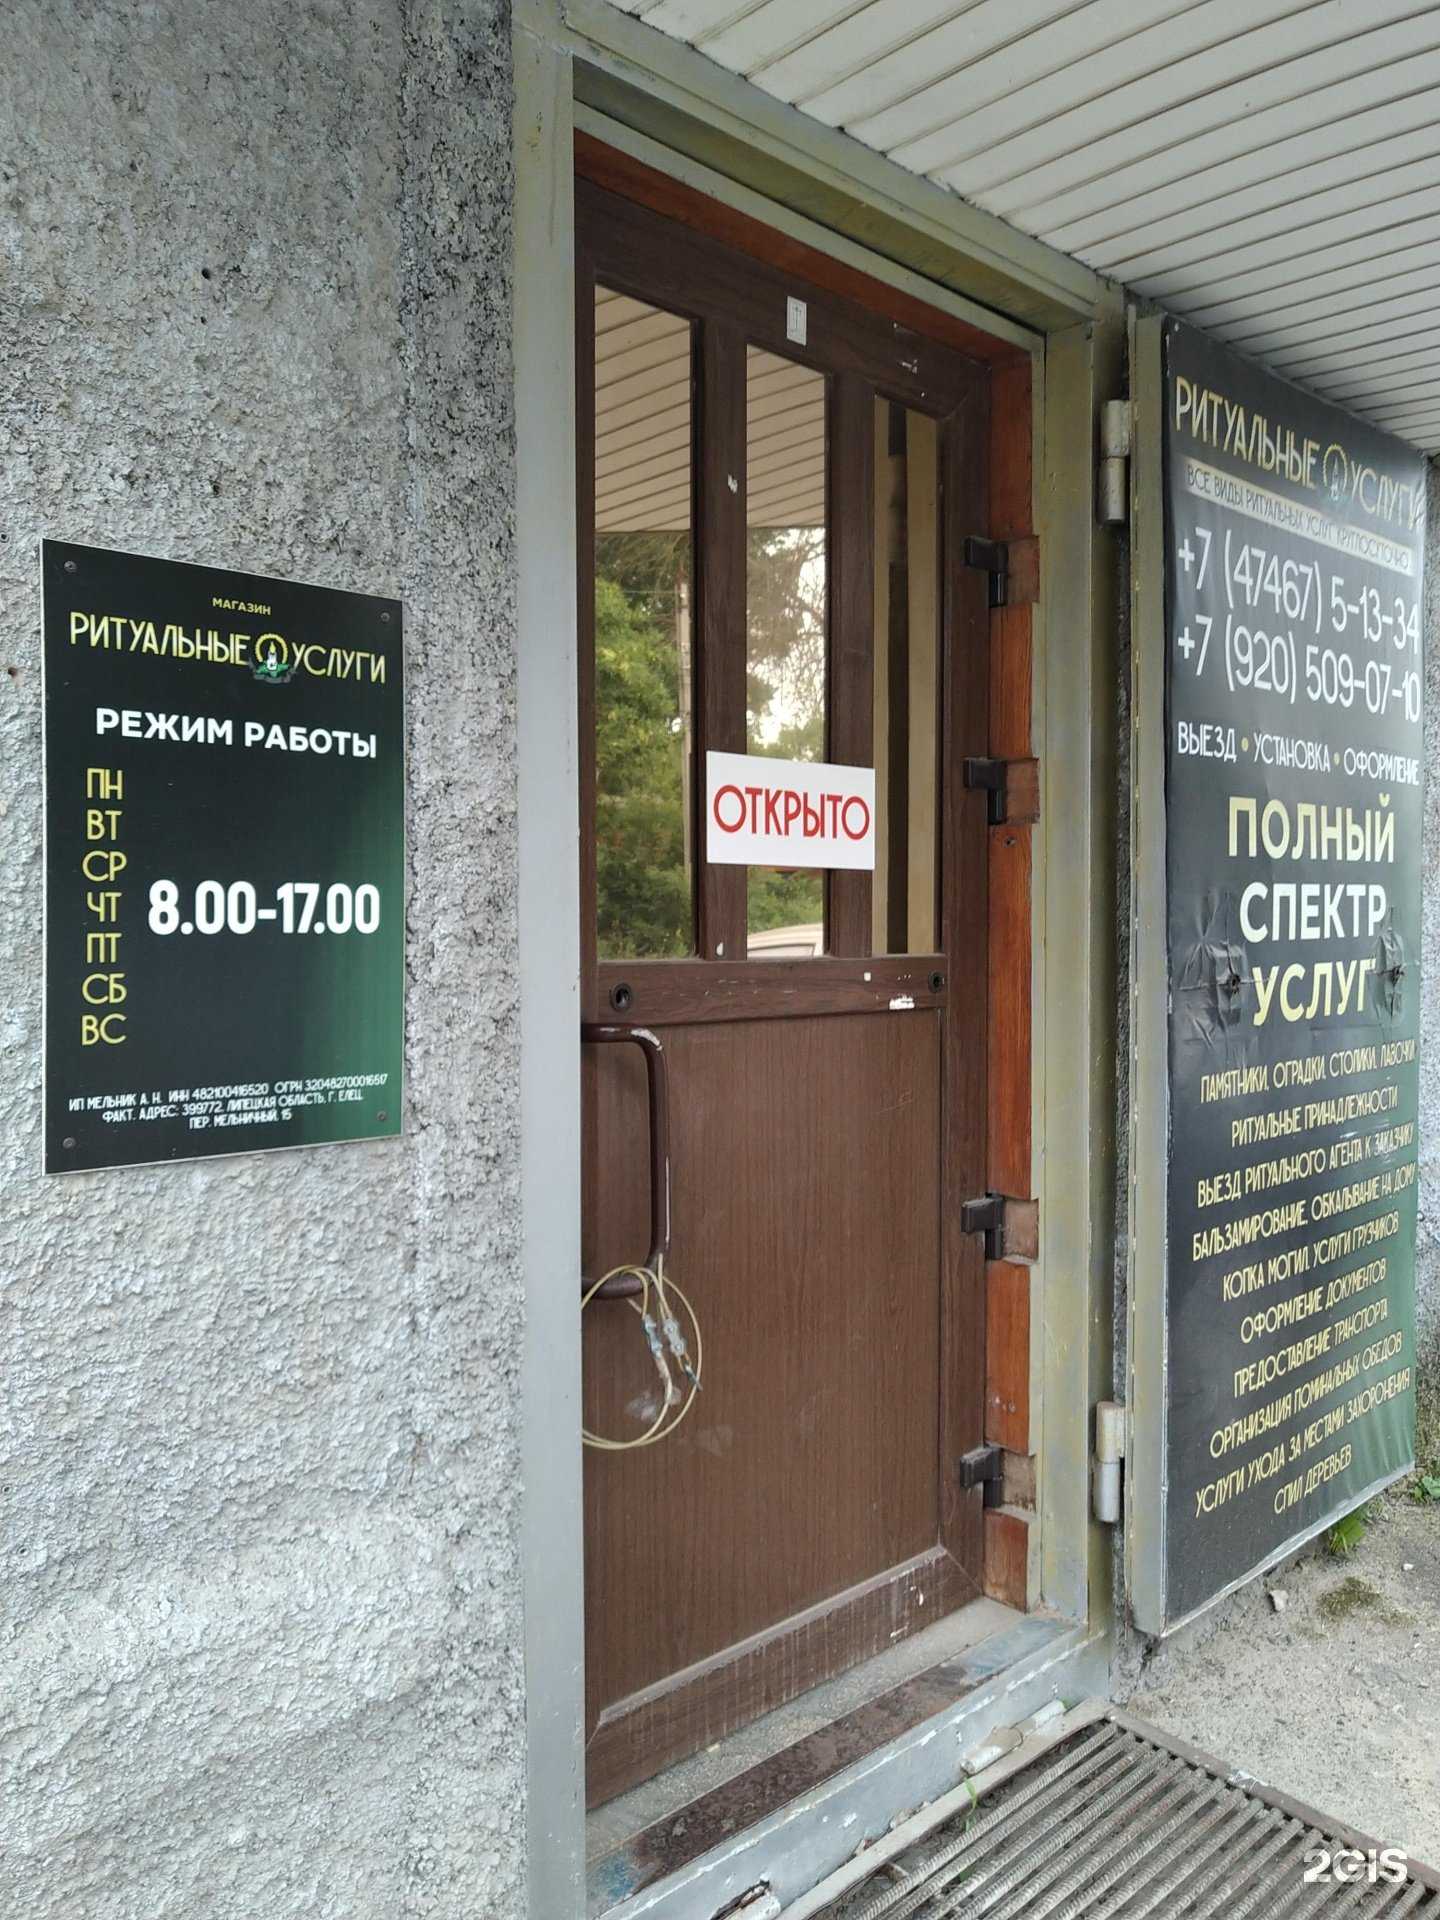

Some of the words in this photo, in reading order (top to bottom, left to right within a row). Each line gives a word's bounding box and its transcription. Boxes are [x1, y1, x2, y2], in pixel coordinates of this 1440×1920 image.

[1176, 376, 1319, 488] РИТУАЛЬНЫЕ
[1187, 465, 1211, 494] ВСЕ
[1214, 476, 1242, 504] ВИДЫ
[212, 597, 271, 615] МАГАЗИН
[1178, 527, 1212, 590] +7
[1224, 529, 1322, 634] (47467)
[1331, 575, 1419, 654] 5-13-34
[70, 611, 250, 666] РИТУАЛЬНЫЕ
[293, 643, 386, 684] УСЛУГИ
[1178, 615, 1212, 676] +7
[1225, 614, 1296, 704] (920)
[1305, 644, 1421, 721] 509-07-10
[96, 708, 233, 745] РЕЖИМ
[245, 721, 377, 759] РАБОТЫ
[1178, 721, 1237, 762] ВЫЕЗД
[1253, 732, 1330, 773] УСТАНОВКА
[1344, 748, 1419, 785] ОФОРМЛЕНИЕ
[85, 768, 124, 801] ПН
[713, 786, 870, 840] ОТКРЫТО
[86, 809, 122, 841] ВТ
[1229, 793, 1395, 863] ПОЛНЫЙ
[81, 850, 127, 881] СР
[87, 892, 122, 922] ЧТ
[147, 880, 380, 935] 8.00-17.00
[1239, 881, 1387, 943] СПЕКТР
[86, 933, 121, 964] ПТ
[81, 973, 128, 1004] СБ
[1252, 959, 1375, 1026] УСЛУГ
[81, 1014, 128, 1046] ВС
[1380, 1039, 1416, 1066] ЛАВОЧКИ
[69, 1098, 84, 1111] ИП
[87, 1093, 137, 1110] МЕЛЬНИК
[169, 1089, 190, 1102] ИНН
[274, 1081, 303, 1093] ОГРН
[102, 1109, 137, 1123] ФАКТ.
[139, 1105, 180, 1120] АДРЕС:
[227, 1096, 276, 1111] ЛИПЕЦКАЯ
[328, 1091, 337, 1103] Г.
[189, 1114, 212, 1129] ПЕР.
[280, 1109, 293, 1121] 15
[1232, 1107, 1301, 1147] РИТУАЛЬНЫЕ
[1304, 1086, 1399, 1129] ПРИНАДЛЕЖНОСТИ
[1197, 1170, 1242, 1209] ВЫЕЗД
[1245, 1148, 1326, 1194] РИТУАЛЬНОГО
[1329, 1140, 1363, 1171] АГЕНТА
[1364, 1137, 1371, 1159] К
[1311, 1175, 1380, 1222] ОБКАЛЫВАНИЕ
[1381, 1170, 1393, 1196] НА
[1394, 1162, 1416, 1193] ДОМУ
[1223, 1260, 1263, 1300] КОПКА
[1314, 1229, 1352, 1266] УСЛУГИ
[1352, 1209, 1399, 1251] ГРУЗЧИКОВ
[1240, 1288, 1323, 1344] ОФОРМЛЕНИЕ
[1326, 1257, 1387, 1304] ДОКУМЕНТОВ
[1234, 1327, 1332, 1398] ПРЕДОСТАВЛЕНИЕ
[1334, 1298, 1388, 1344] ТРАНСПОРТА
[1210, 1395, 1292, 1459] ОРГАНИЗАЦИЯ
[1294, 1357, 1360, 1413] ПОМИНАЛЬНЫХ
[1362, 1331, 1402, 1371] ОБЕДОВ
[1195, 1464, 1244, 1519] УСЛУГИ
[1247, 1442, 1285, 1487] УХОДА
[1288, 1436, 1301, 1463] ЗА
[1303, 1406, 1344, 1453] МЕСТАМИ
[1347, 1367, 1411, 1423] ЗАХОРОНЕНИЯ
[1274, 1474, 1303, 1515] СПИЛ
[1305, 1444, 1352, 1496] ДЕРЕВЬЕВ
